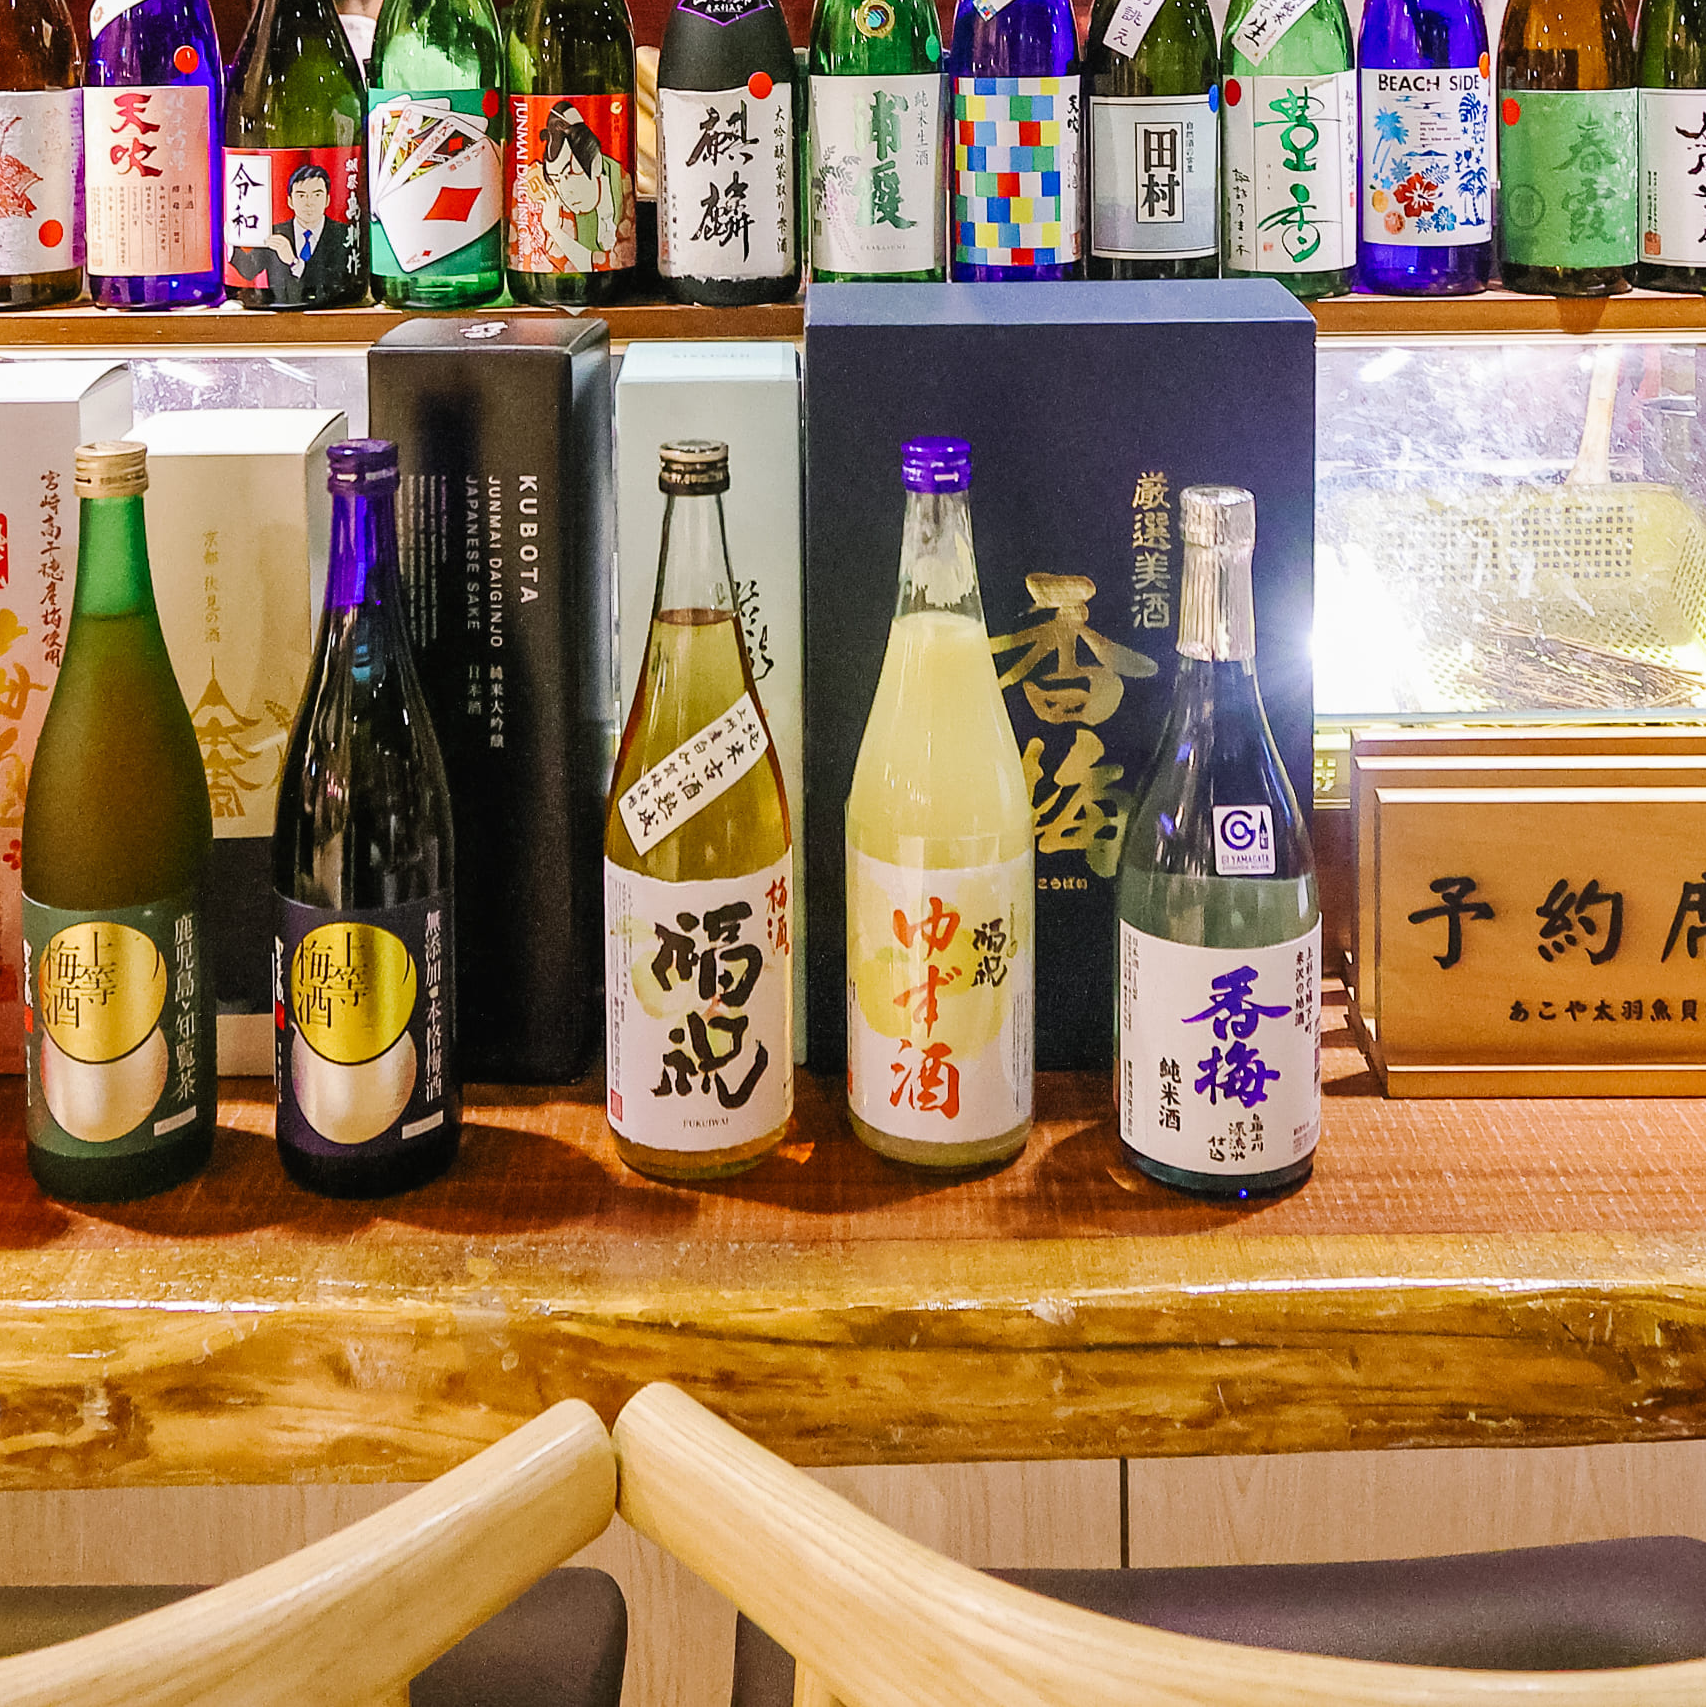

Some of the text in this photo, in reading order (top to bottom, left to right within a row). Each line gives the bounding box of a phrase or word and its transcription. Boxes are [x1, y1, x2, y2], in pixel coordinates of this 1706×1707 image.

[1378, 74, 1440, 91] BEACH
[110, 93, 163, 177] 天吹
[513, 100, 529, 160] JUNMAI
[915, 90, 928, 166] 純米生酒
[1141, 128, 1180, 217] 田村
[231, 162, 265, 238] 令和
[686, 100, 759, 262] 麒麟
[1552, 111, 1618, 244] 春霞
[466, 475, 480, 630] JAPANESE SAKE
[488, 476, 503, 648] JUNMAI DAIGINJO
[518, 475, 539, 603] KUBOTA
[1132, 471, 1172, 630] 厳選美酒
[45, 940, 81, 1028] 梅酒
[77, 931, 117, 1006] 上等
[296, 940, 334, 1029] 梅酒
[330, 931, 369, 1007] 上等
[971, 917, 1008, 987] 福祝
[650, 901, 769, 1110] 福祝
[889, 896, 963, 1120] ゆず酒
[1181, 965, 1292, 1108] 香梅
[1159, 1056, 1182, 1132] 純米酒
